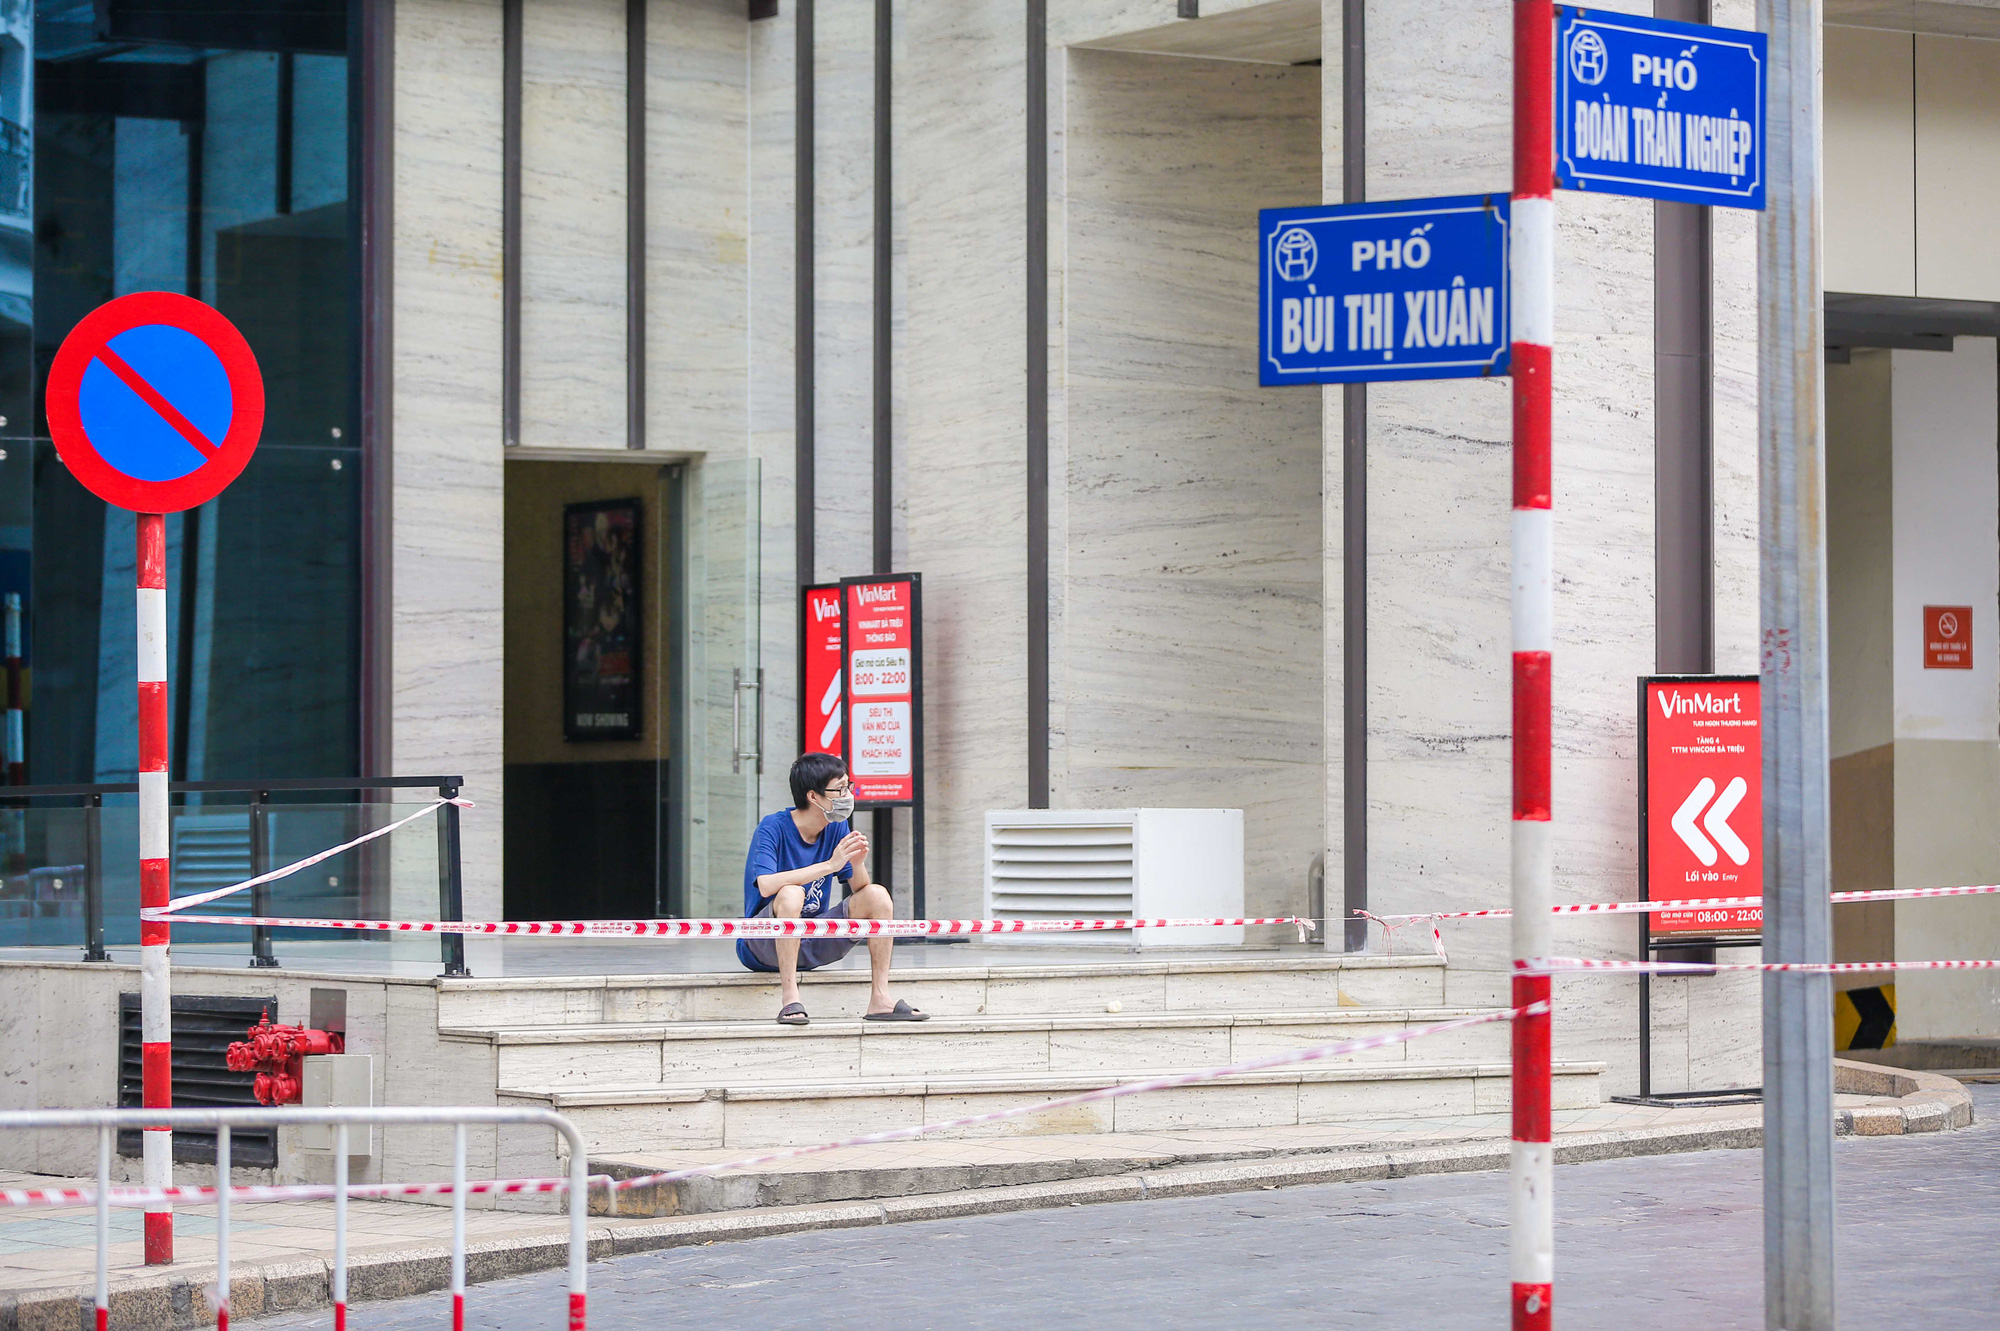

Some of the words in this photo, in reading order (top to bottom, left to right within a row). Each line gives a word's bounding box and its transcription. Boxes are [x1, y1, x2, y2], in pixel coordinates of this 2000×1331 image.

[1632, 45, 1698, 91] PHỐ
[1575, 92, 1629, 163] ĐOÀN
[1685, 107, 1752, 186] NGHIỆP
[1352, 223, 1434, 271] PHỐ
[1282, 283, 1335, 354] BÙI
[1344, 292, 1394, 361] THỊ
[1403, 275, 1493, 348] XUÂN
[856, 585, 897, 606] VinMart
[813, 597, 841, 622] VinM
[855, 672, 874, 685] 8:00
[881, 671, 906, 684] 22:00
[1657, 690, 1741, 719] VinMart
[1689, 745, 1716, 753] VINCOM
[1717, 744, 1726, 753] BÀ
[1727, 744, 1745, 754] TRIỆU
[1685, 869, 1699, 882] Lối
[1701, 870, 1719, 882] vào
[1722, 873, 1738, 883] Entry
[1697, 911, 1728, 922] 08:00
[1737, 909, 1763, 921] 22:00
